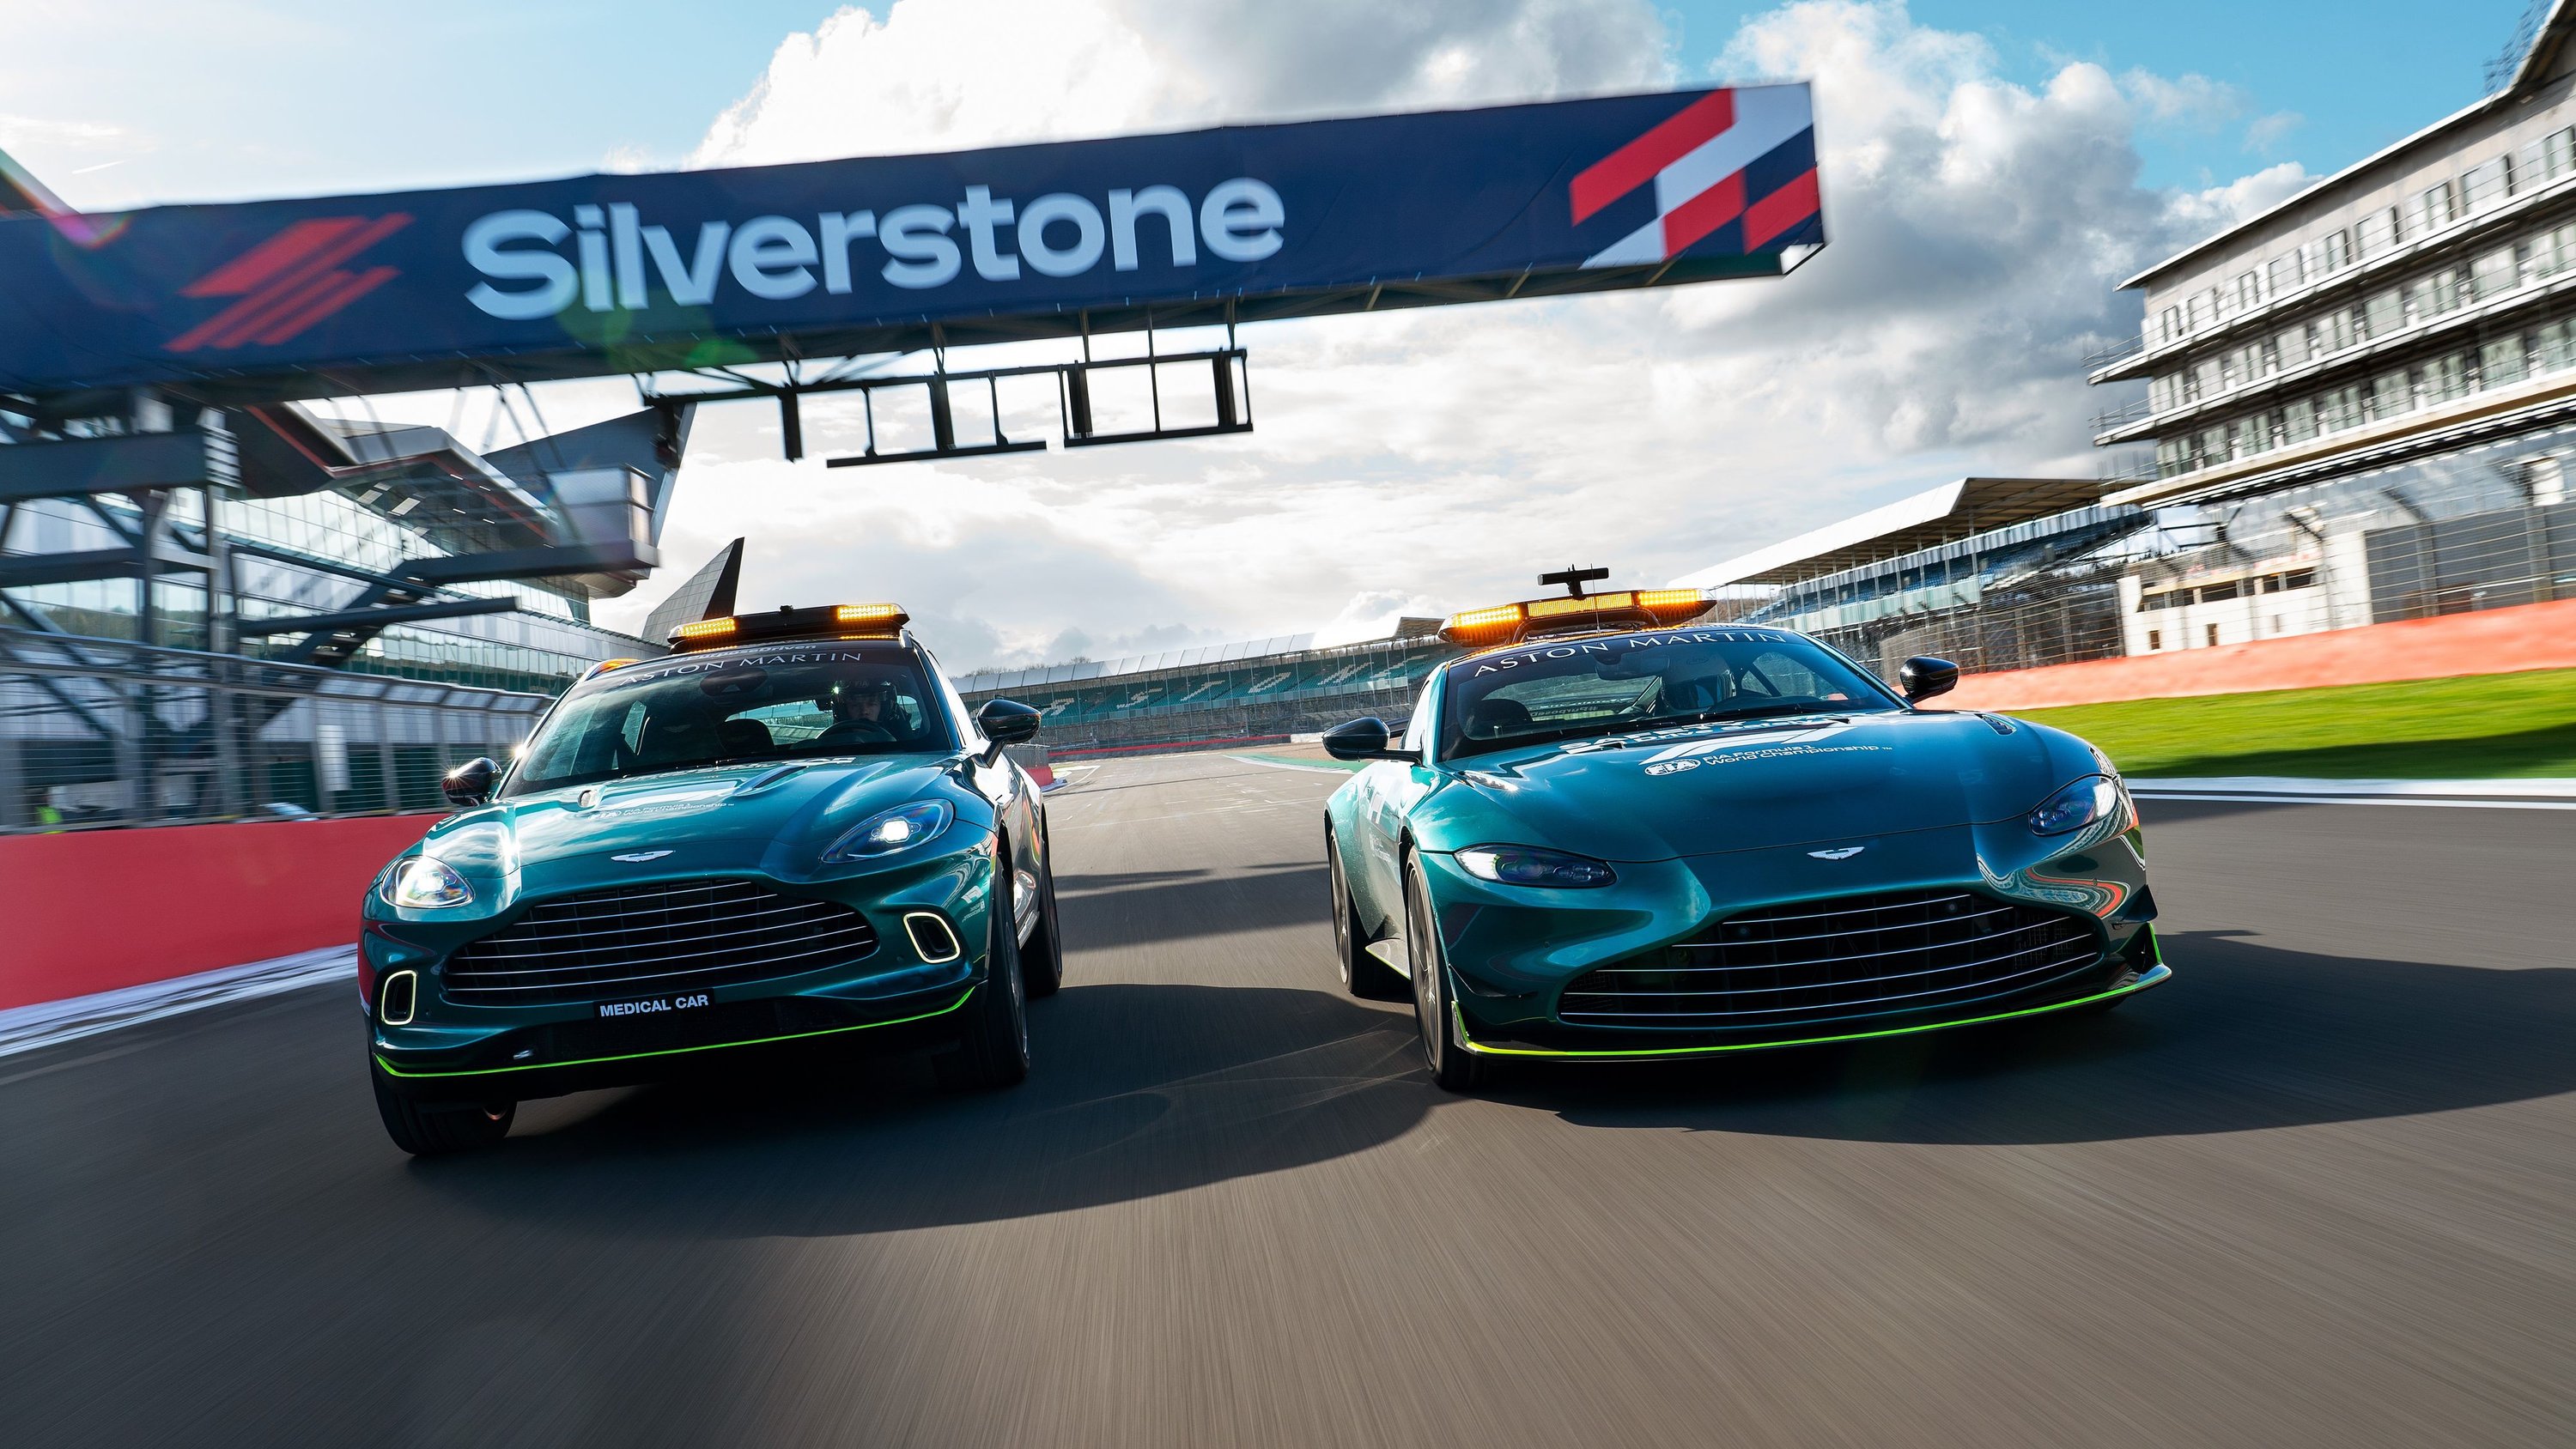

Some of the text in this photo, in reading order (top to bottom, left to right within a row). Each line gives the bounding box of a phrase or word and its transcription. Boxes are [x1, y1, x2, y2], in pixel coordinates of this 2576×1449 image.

[461, 176, 1285, 321] Silverstone
[1474, 631, 1787, 677] ASTON MARTIN
[620, 652, 861, 686] ASTON MARTIN
[1705, 755, 1758, 766] World
[1759, 745, 1880, 758] Championship
[1733, 746, 1803, 757] Formula
[1647, 759, 1696, 776] FIA
[599, 994, 709, 1017] MEDICAL CAR
